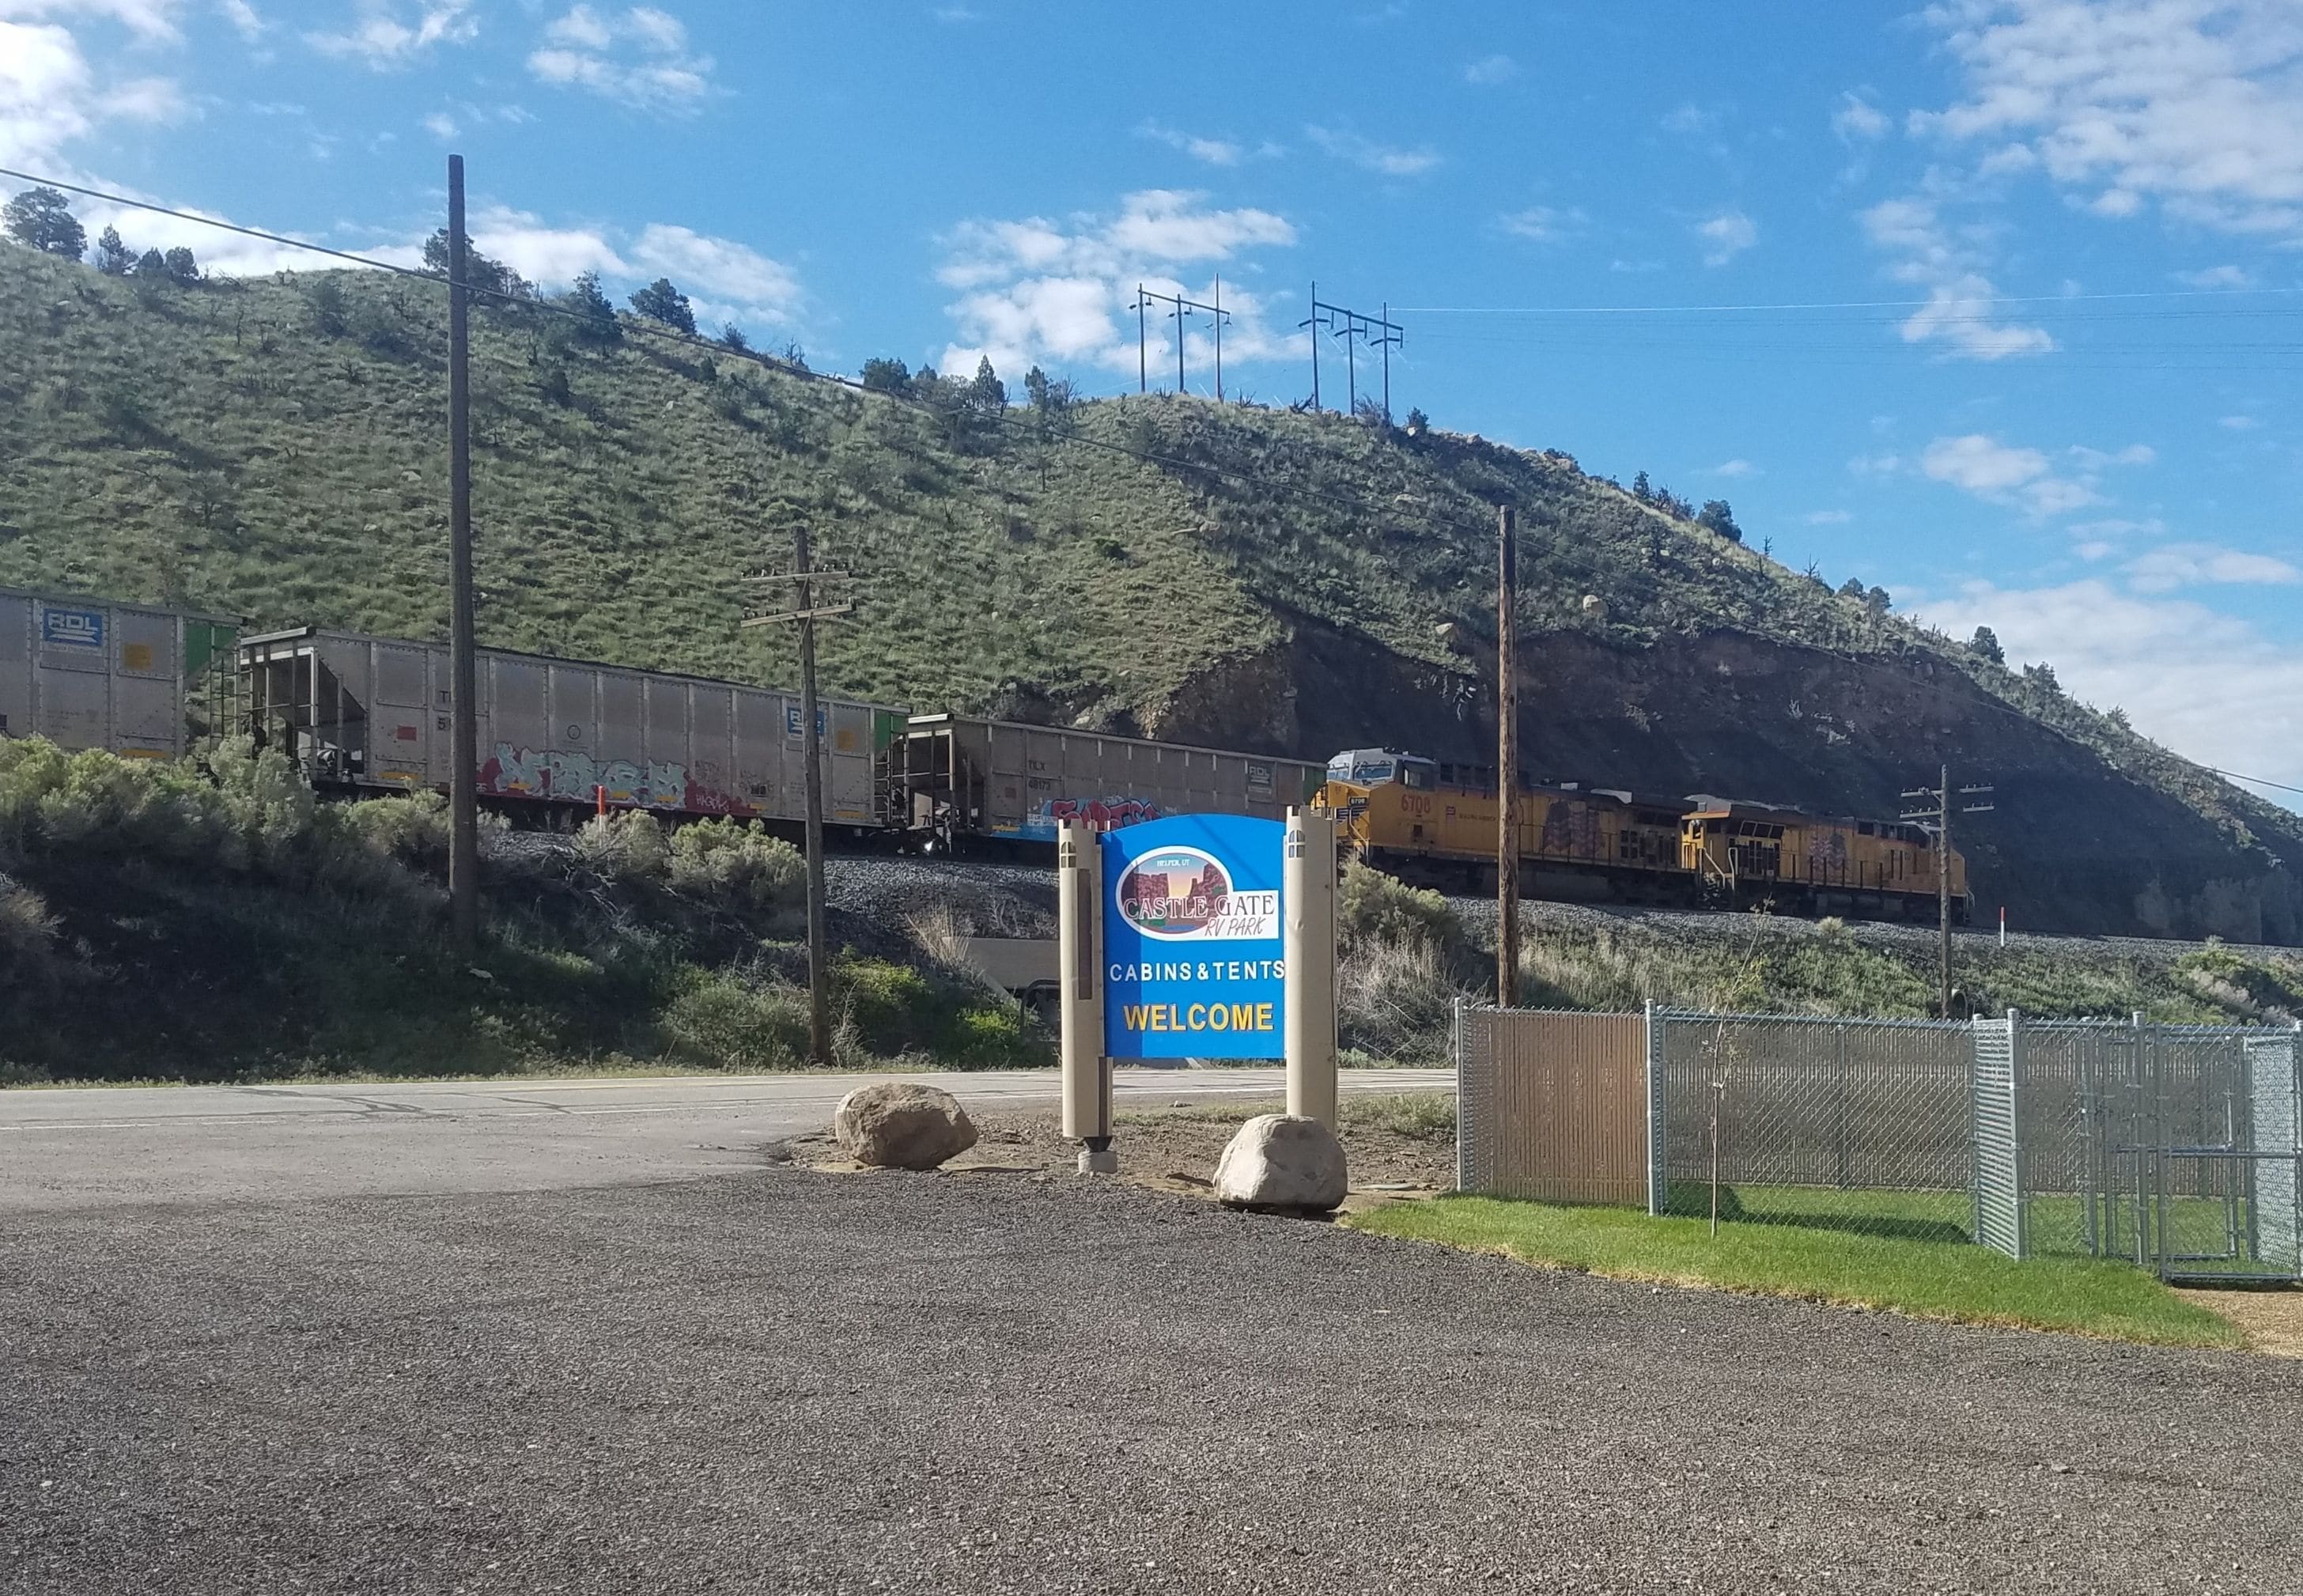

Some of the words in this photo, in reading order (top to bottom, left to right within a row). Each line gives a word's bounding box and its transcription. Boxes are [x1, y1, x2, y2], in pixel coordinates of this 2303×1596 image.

[1123, 896, 1208, 921] CASTLE
[1215, 894, 1275, 917] GATE
[1204, 917, 1226, 937] RV
[1227, 917, 1266, 936] PARK
[1110, 962, 1192, 981] CABINS
[1212, 959, 1285, 981] TENTS
[1123, 1003, 1274, 1031] WELCOME
